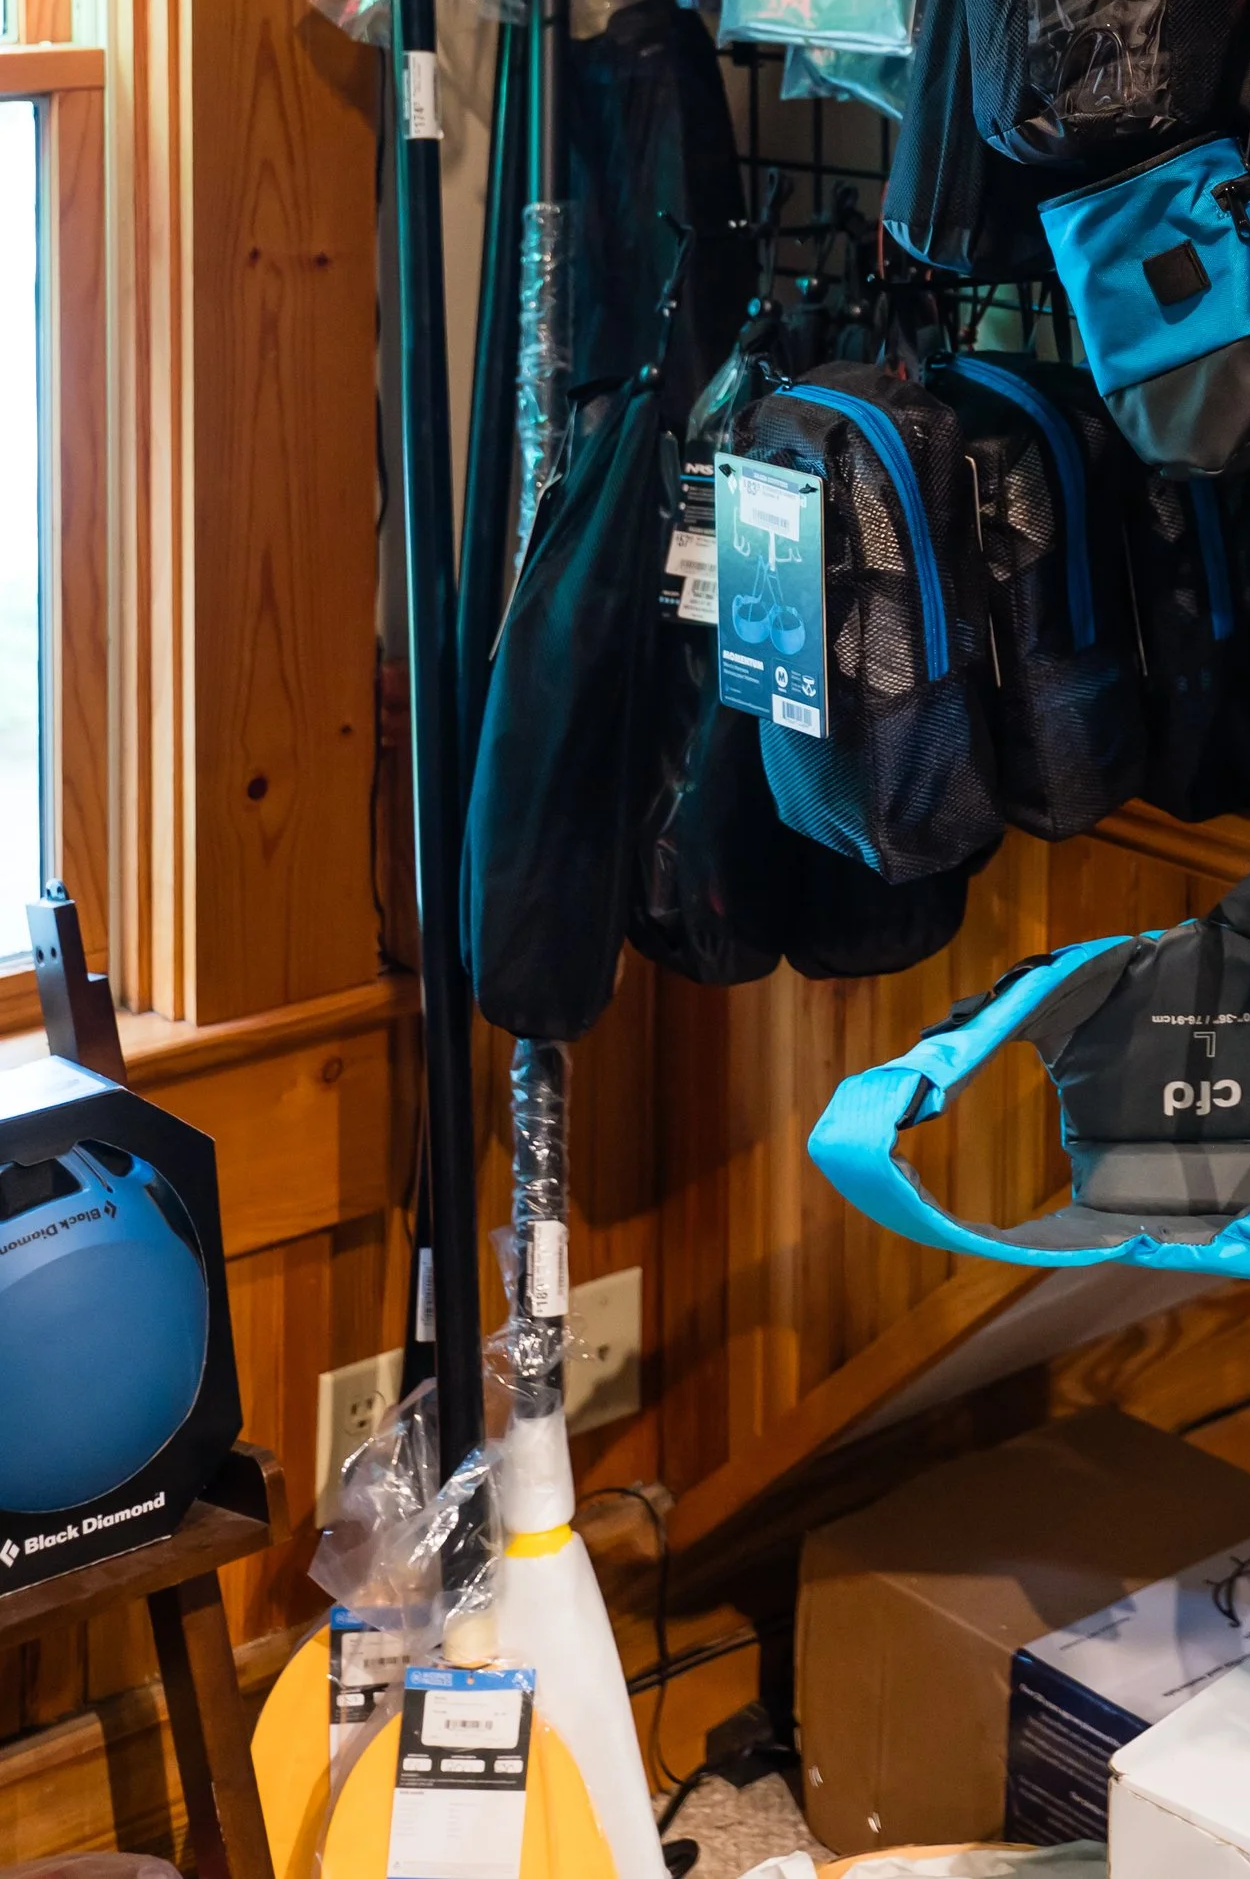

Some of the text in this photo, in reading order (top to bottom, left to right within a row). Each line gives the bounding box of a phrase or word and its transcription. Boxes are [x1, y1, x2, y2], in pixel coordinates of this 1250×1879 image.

[685, 462, 714, 476] NRS
[1193, 1031, 1217, 1058] L
[1163, 1078, 1243, 1117] cfd
[59, 1208, 102, 1232] Black
[24, 1490, 166, 1556] Black Diamond
